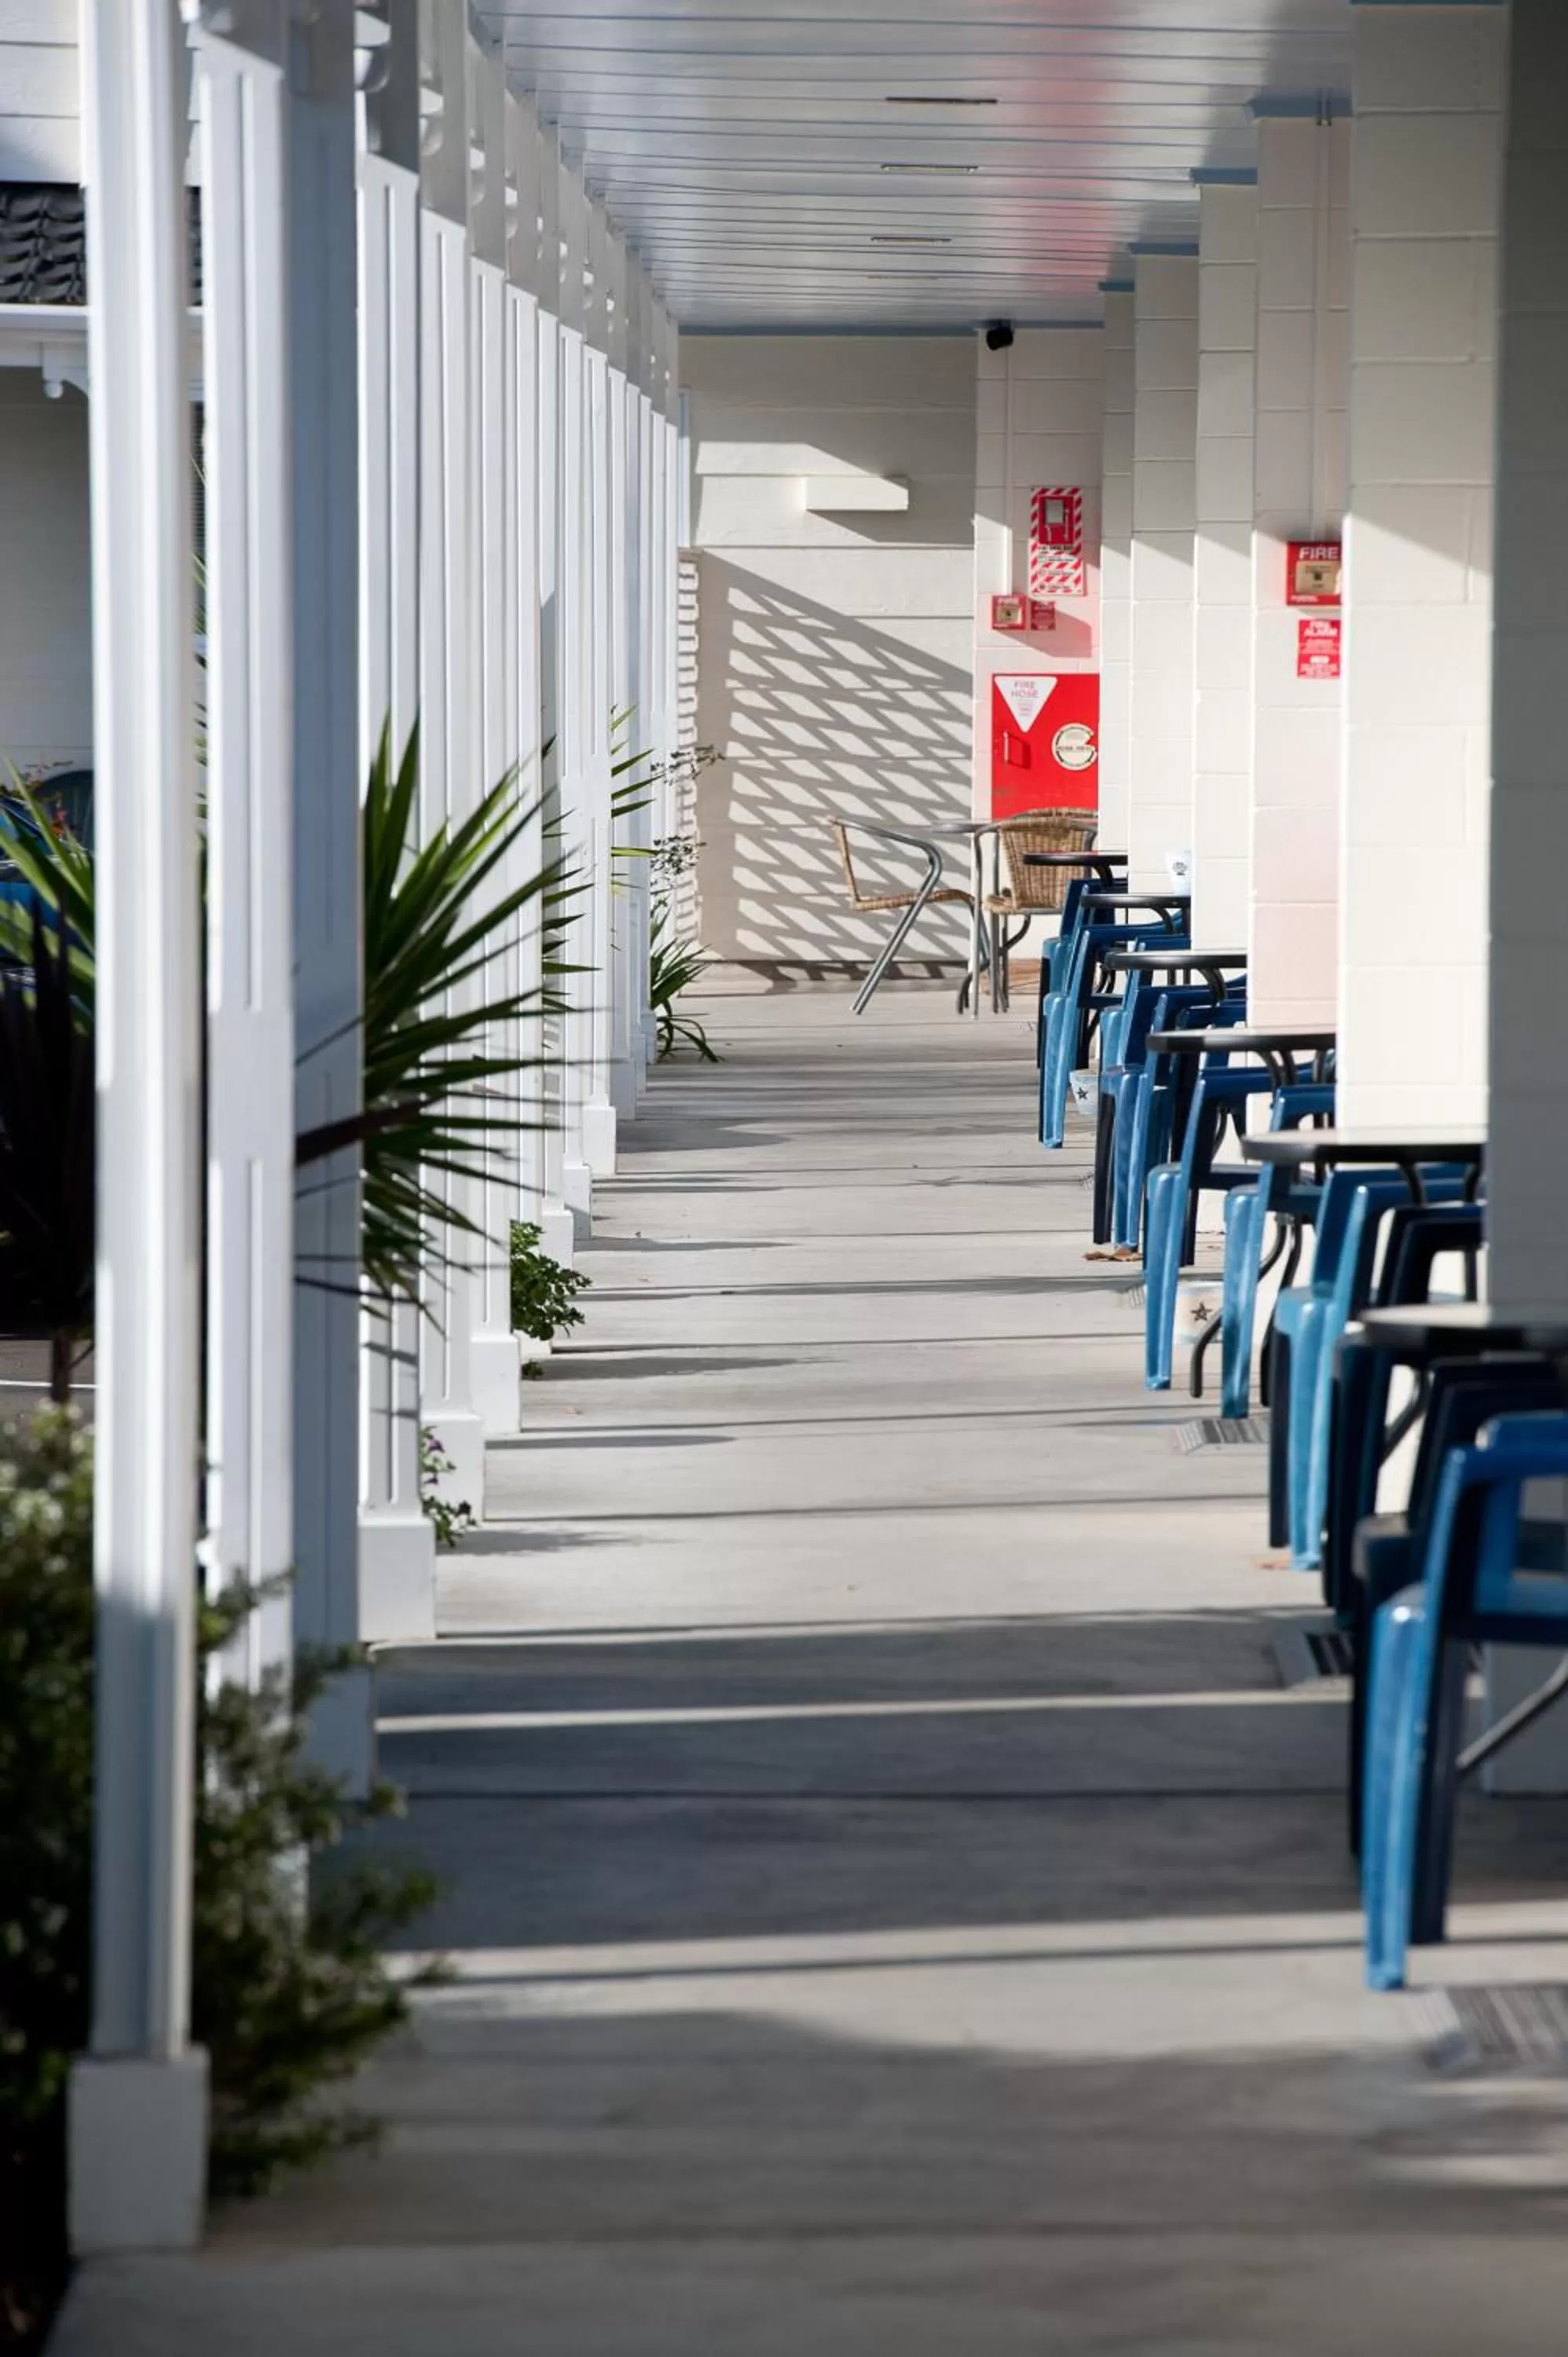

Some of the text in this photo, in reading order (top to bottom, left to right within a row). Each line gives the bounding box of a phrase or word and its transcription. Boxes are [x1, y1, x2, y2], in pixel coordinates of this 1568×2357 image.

[1299, 547, 1339, 559] FIRE
[1013, 681, 1035, 690] FIRE
[1011, 690, 1039, 698] HOSE
